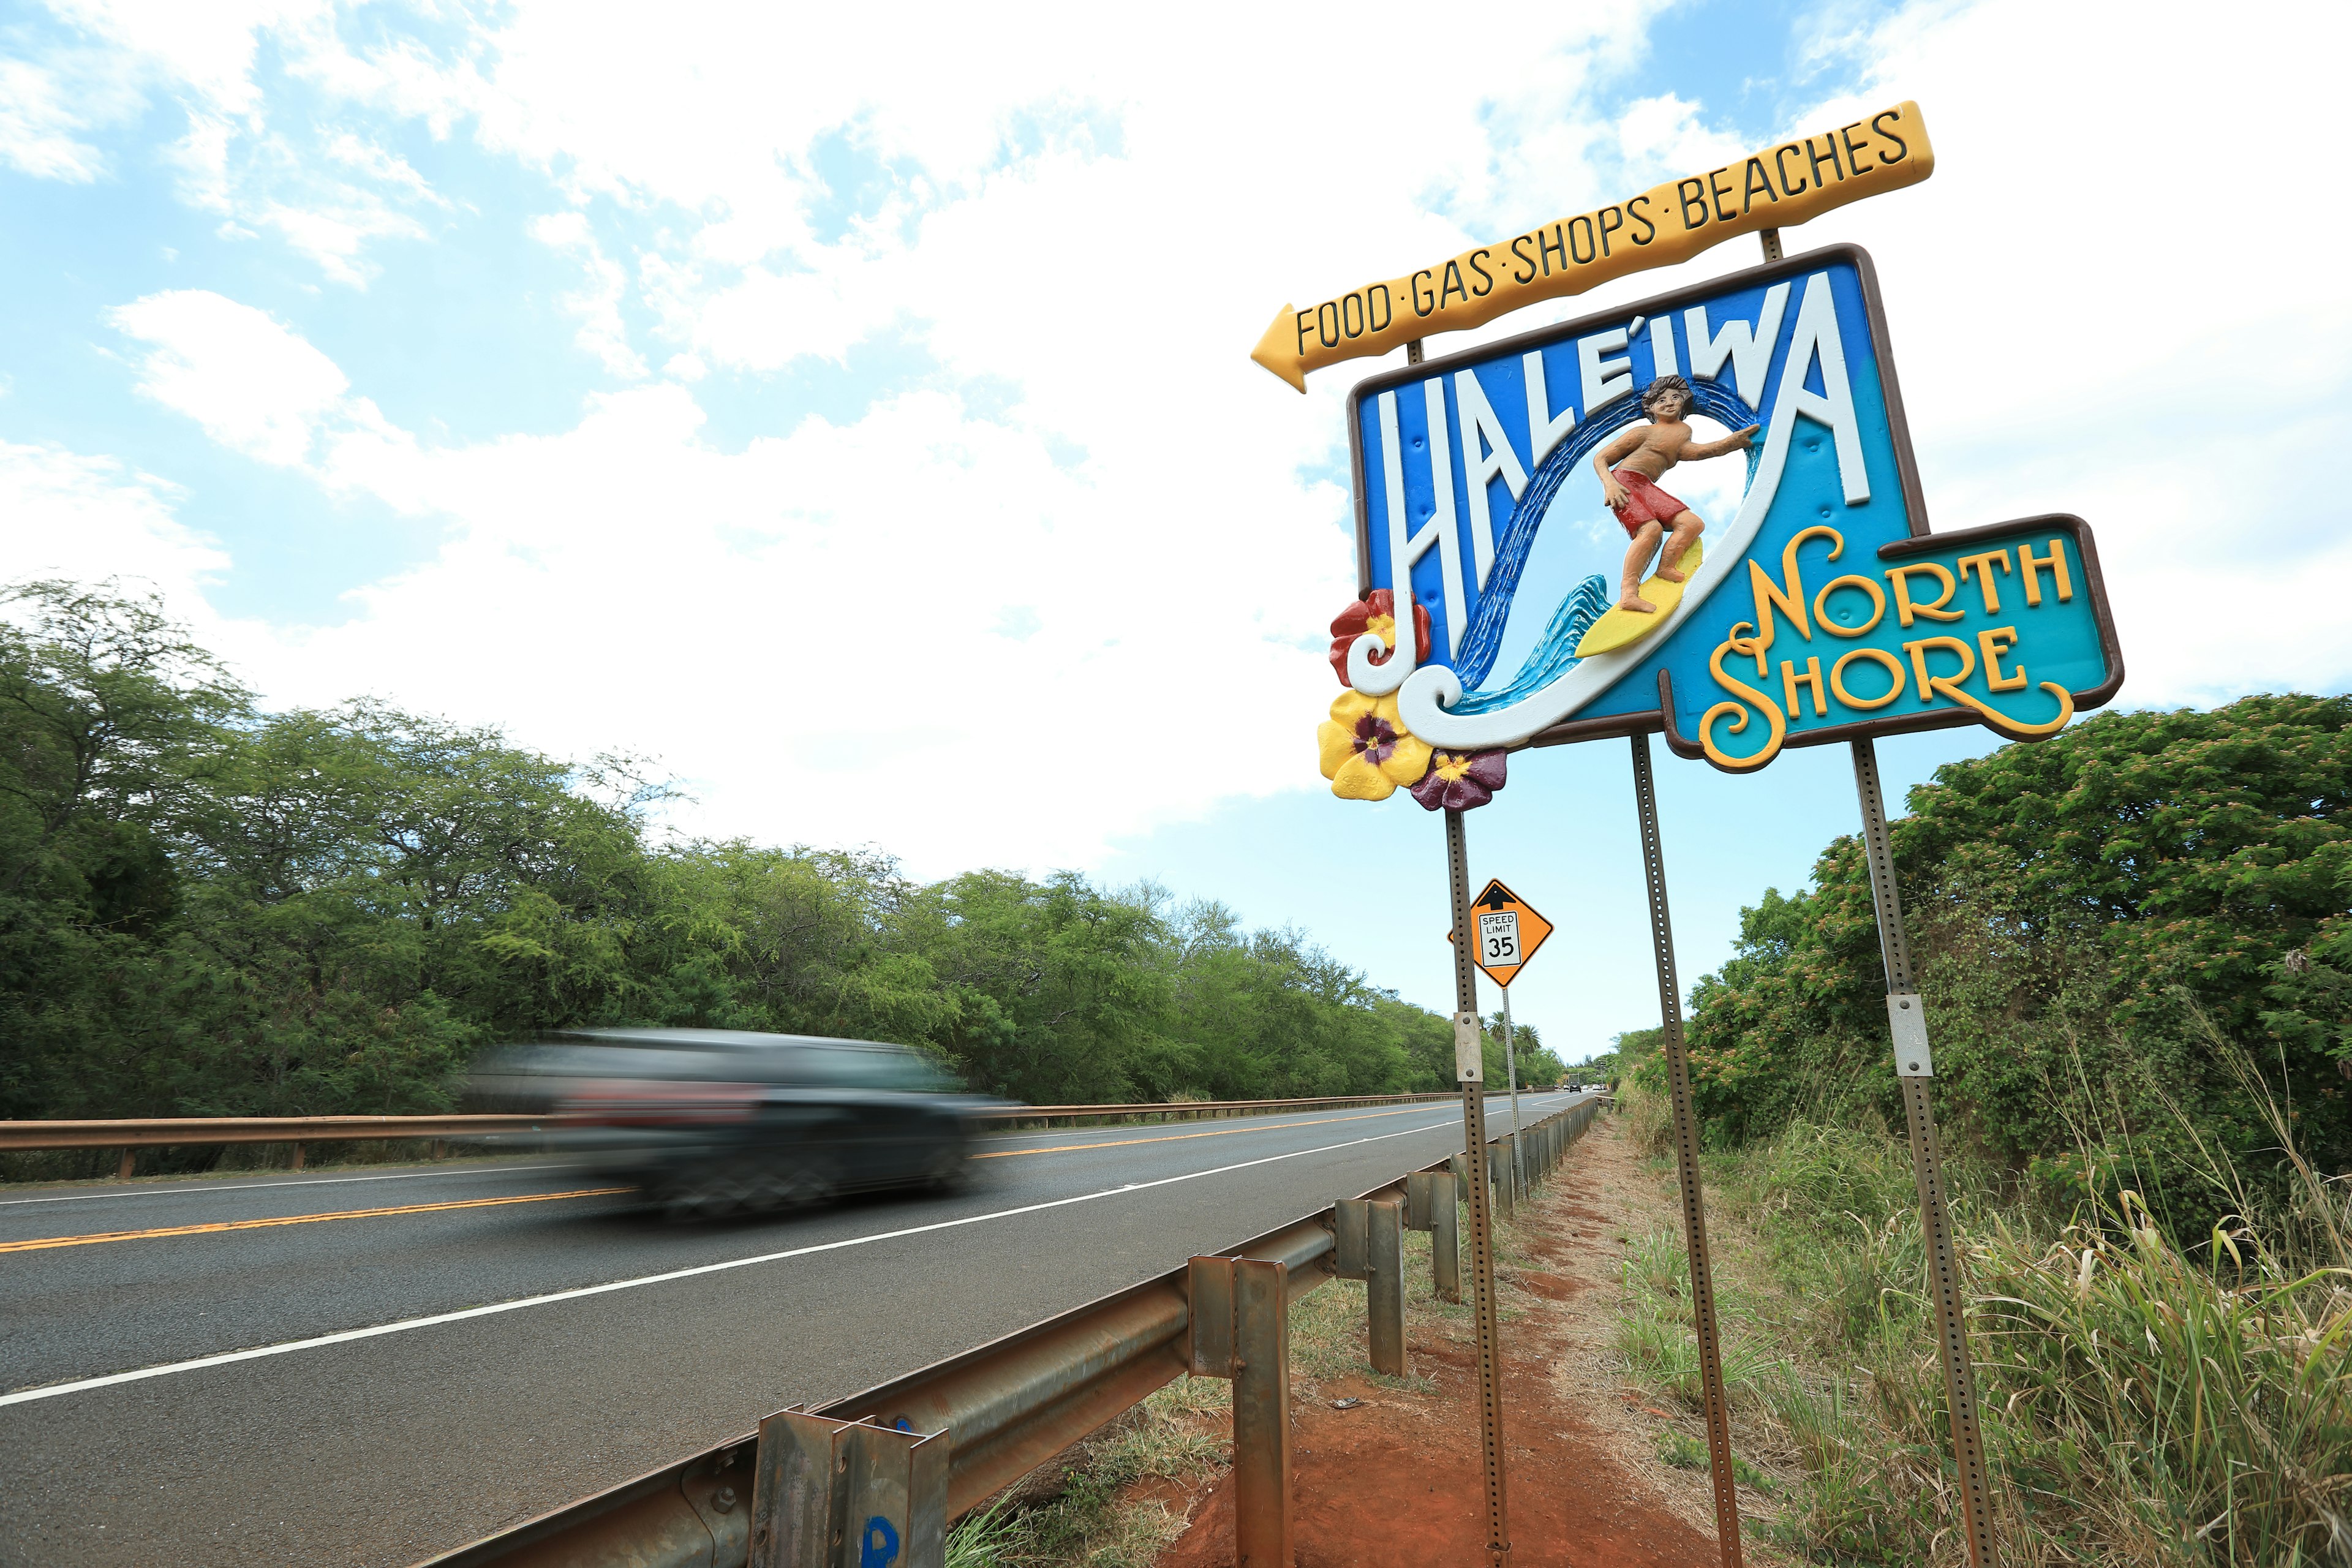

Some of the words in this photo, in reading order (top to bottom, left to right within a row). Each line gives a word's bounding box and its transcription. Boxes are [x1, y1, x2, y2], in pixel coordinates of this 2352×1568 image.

[1296, 284, 1392, 356] FOOD
[1411, 249, 1494, 317] GAS
[1510, 196, 1656, 285] SHOPS
[1677, 110, 1909, 230] BEACHES
[1729, 525, 2073, 655] NORTH
[1698, 625, 2075, 769] SHORE
[1483, 916, 1513, 925] SPEED
[1487, 924, 1511, 933] LIMIT
[1488, 937, 1514, 957] 35
